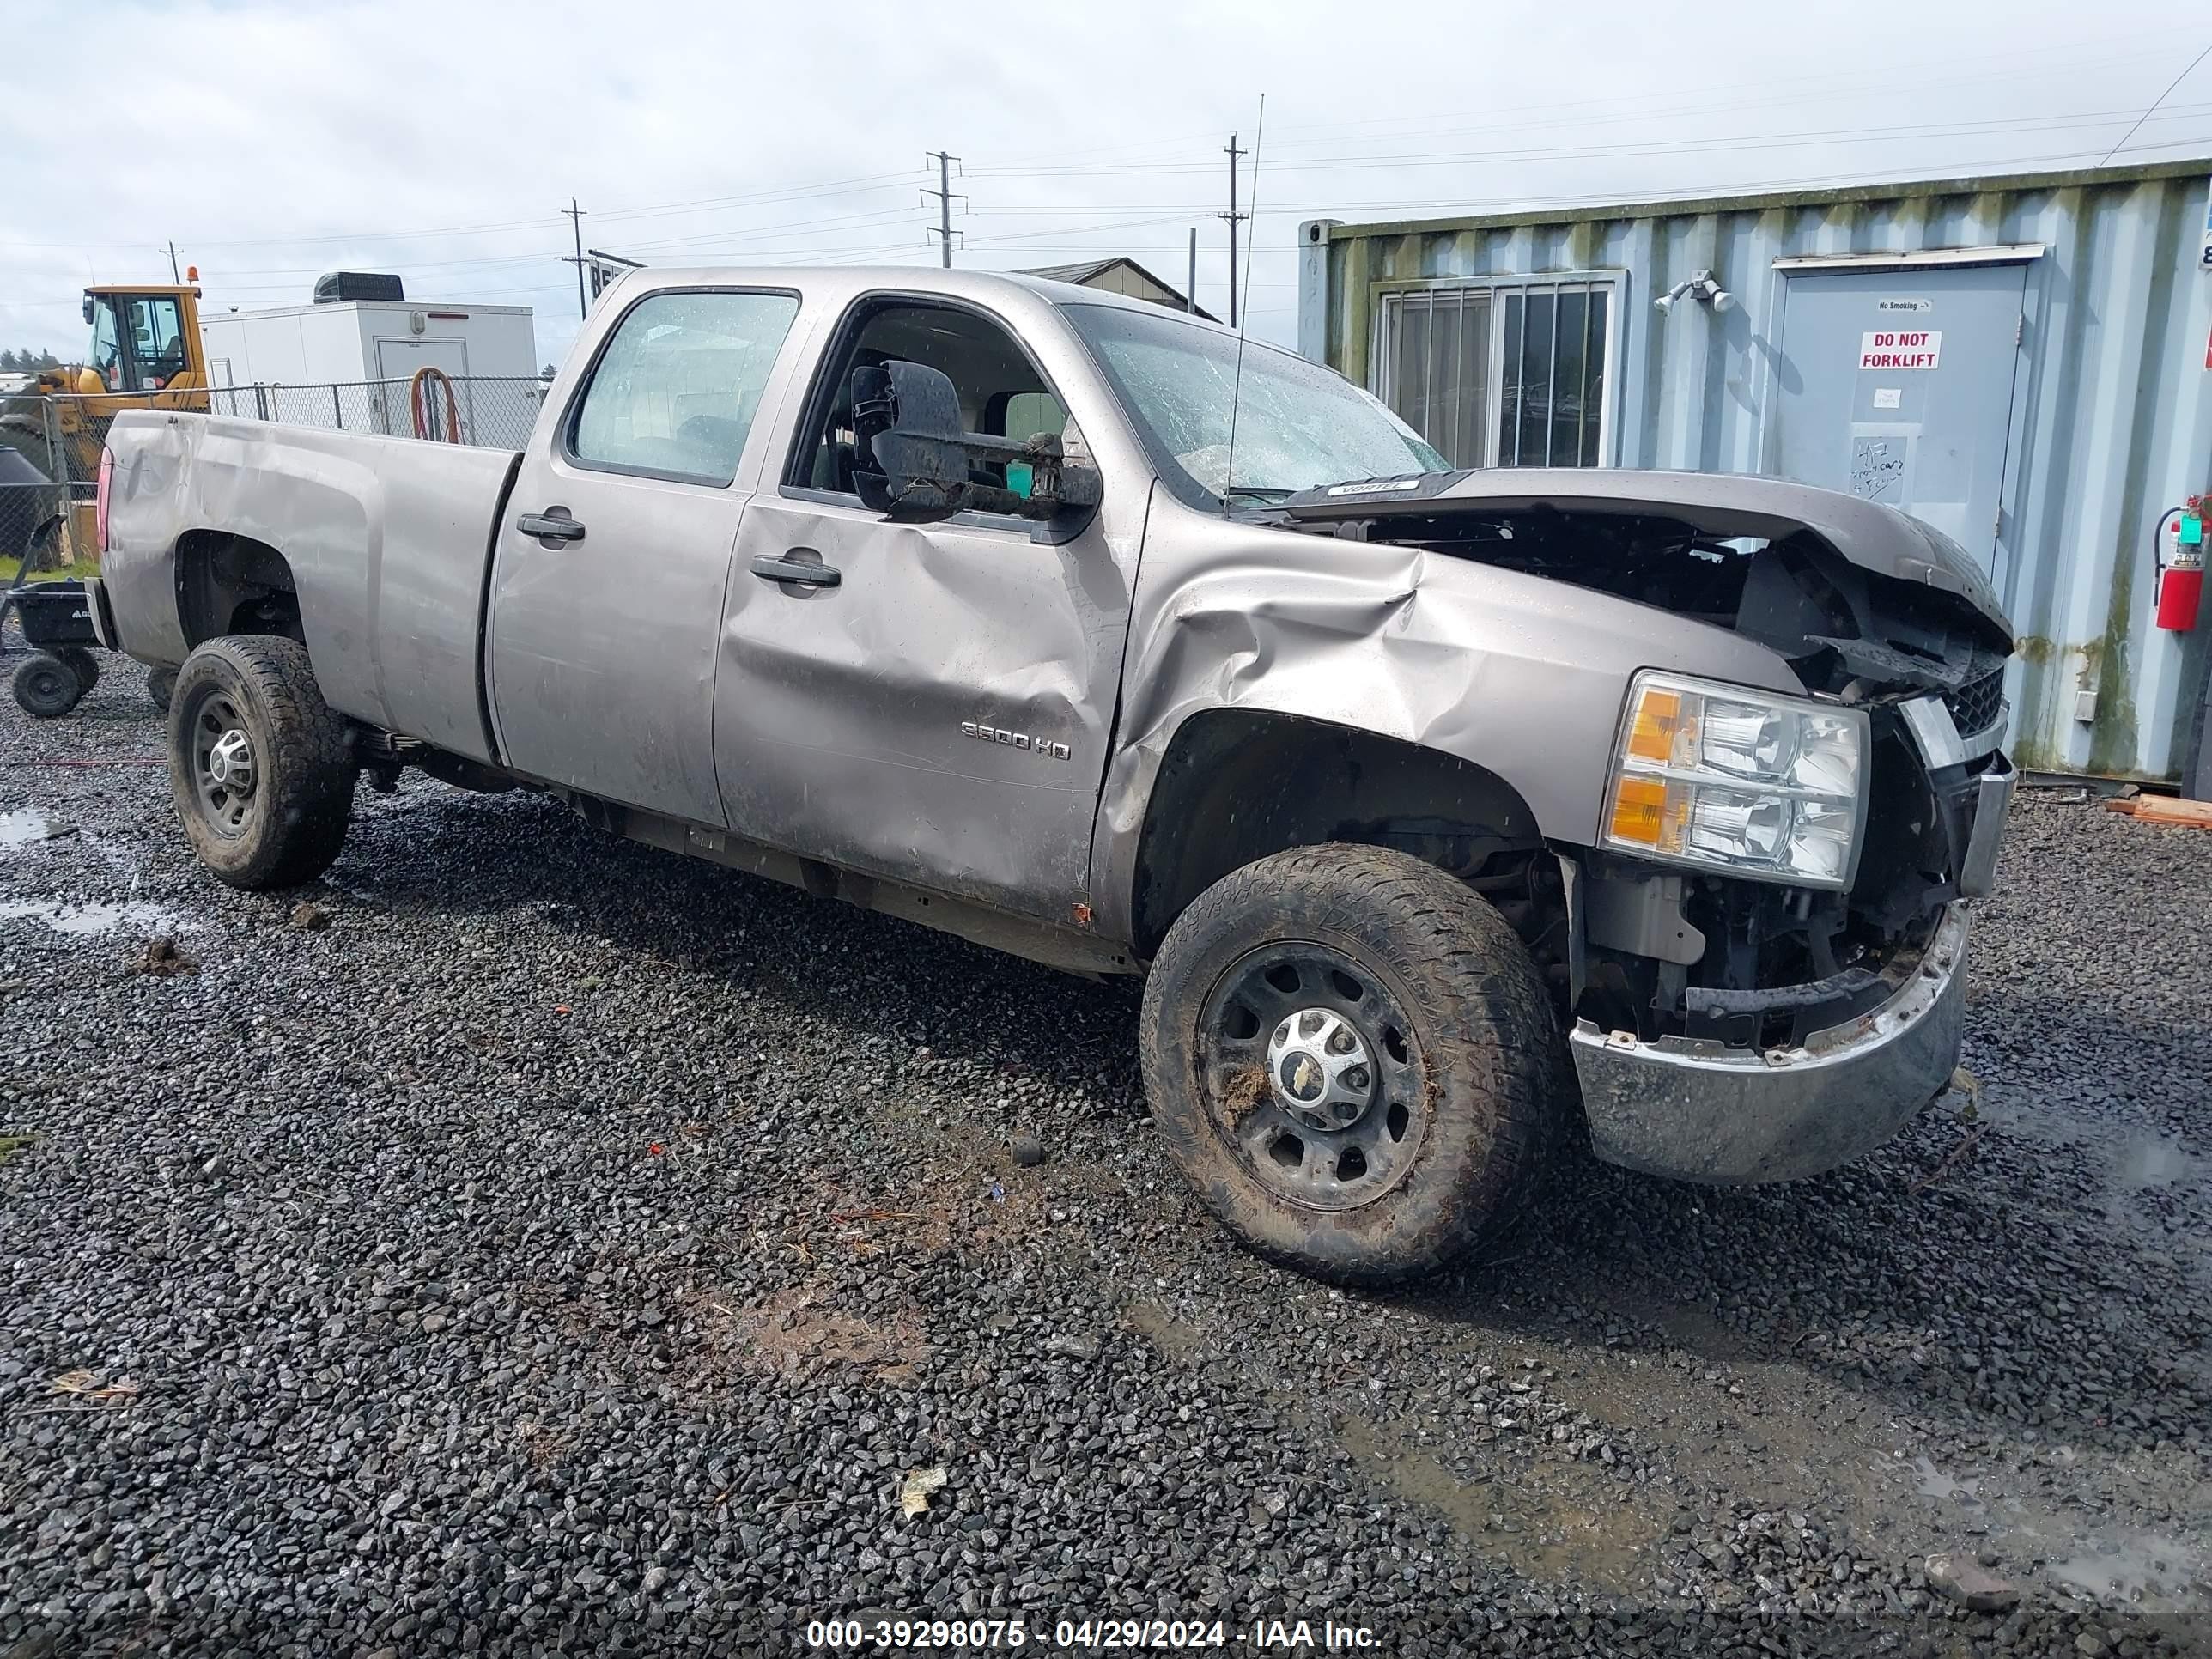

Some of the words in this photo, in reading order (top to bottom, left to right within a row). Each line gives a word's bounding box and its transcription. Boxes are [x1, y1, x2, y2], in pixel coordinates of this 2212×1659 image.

[1889, 301, 1917, 311] Smoking
[1875, 333, 1894, 347] DO
[1899, 333, 1929, 346] NOT
[1863, 354, 1936, 368] FORKLIFT
[1342, 482, 1402, 493] VORTEC
[961, 721, 1031, 750] 3500
[1035, 736, 1072, 761] HD
